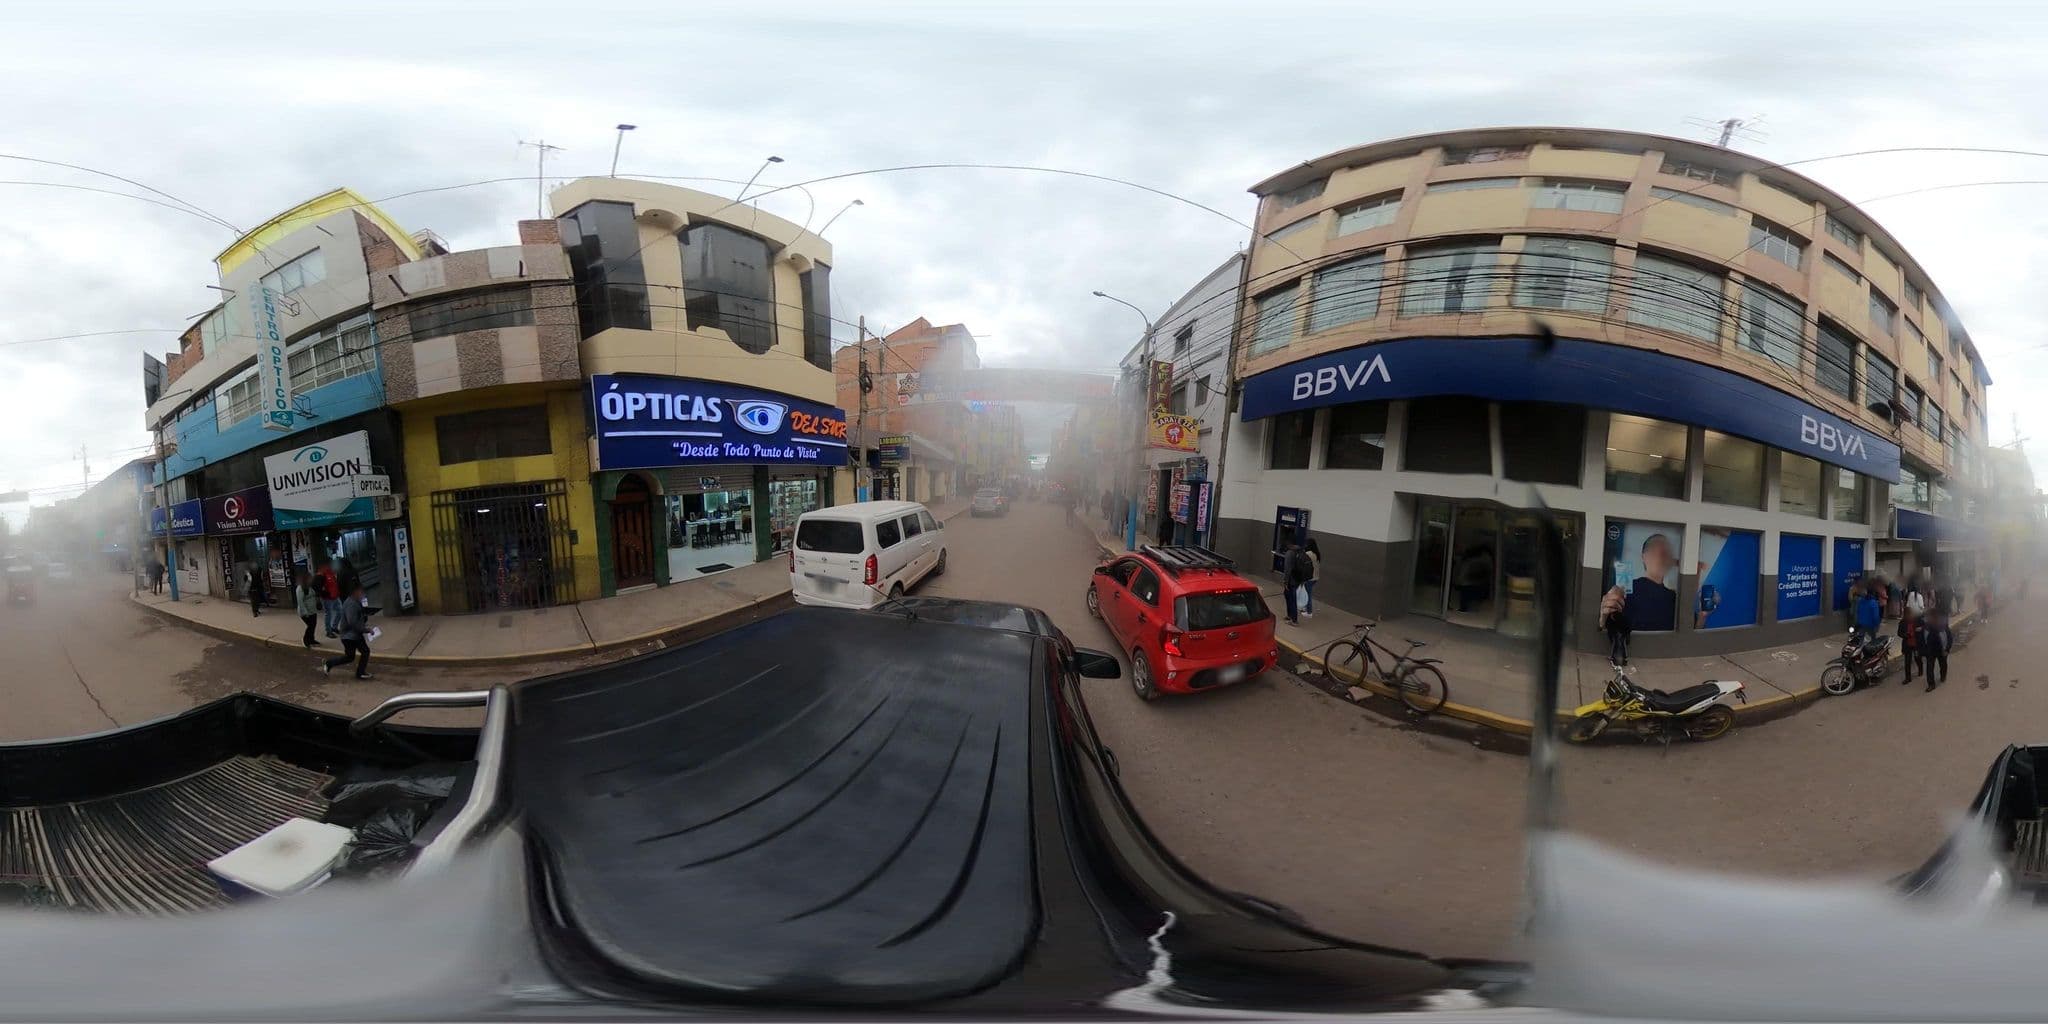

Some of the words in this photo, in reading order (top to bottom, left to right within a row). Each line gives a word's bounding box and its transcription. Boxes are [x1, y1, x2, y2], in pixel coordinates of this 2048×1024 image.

[262, 288, 279, 341] CENTRO
[271, 346, 287, 410] OPTICO
[1293, 354, 1391, 400] BBVA
[601, 383, 723, 423] ÓPTICAS
[789, 411, 818, 434] DEL
[820, 417, 847, 438] SUR
[1801, 415, 1867, 460] BBVA
[723, 443, 750, 457] Todo
[753, 444, 782, 458] Punto
[783, 446, 794, 458] de
[272, 457, 361, 491] UNIVISION
[360, 480, 382, 492] OPTICA
[216, 521, 237, 529] Vision
[238, 518, 259, 527] Moon
[220, 539, 233, 583] OPTICA
[397, 531, 412, 603] OPTICA
[1786, 573, 1810, 582] Tarjetas
[1778, 582, 1801, 590] Crédito
